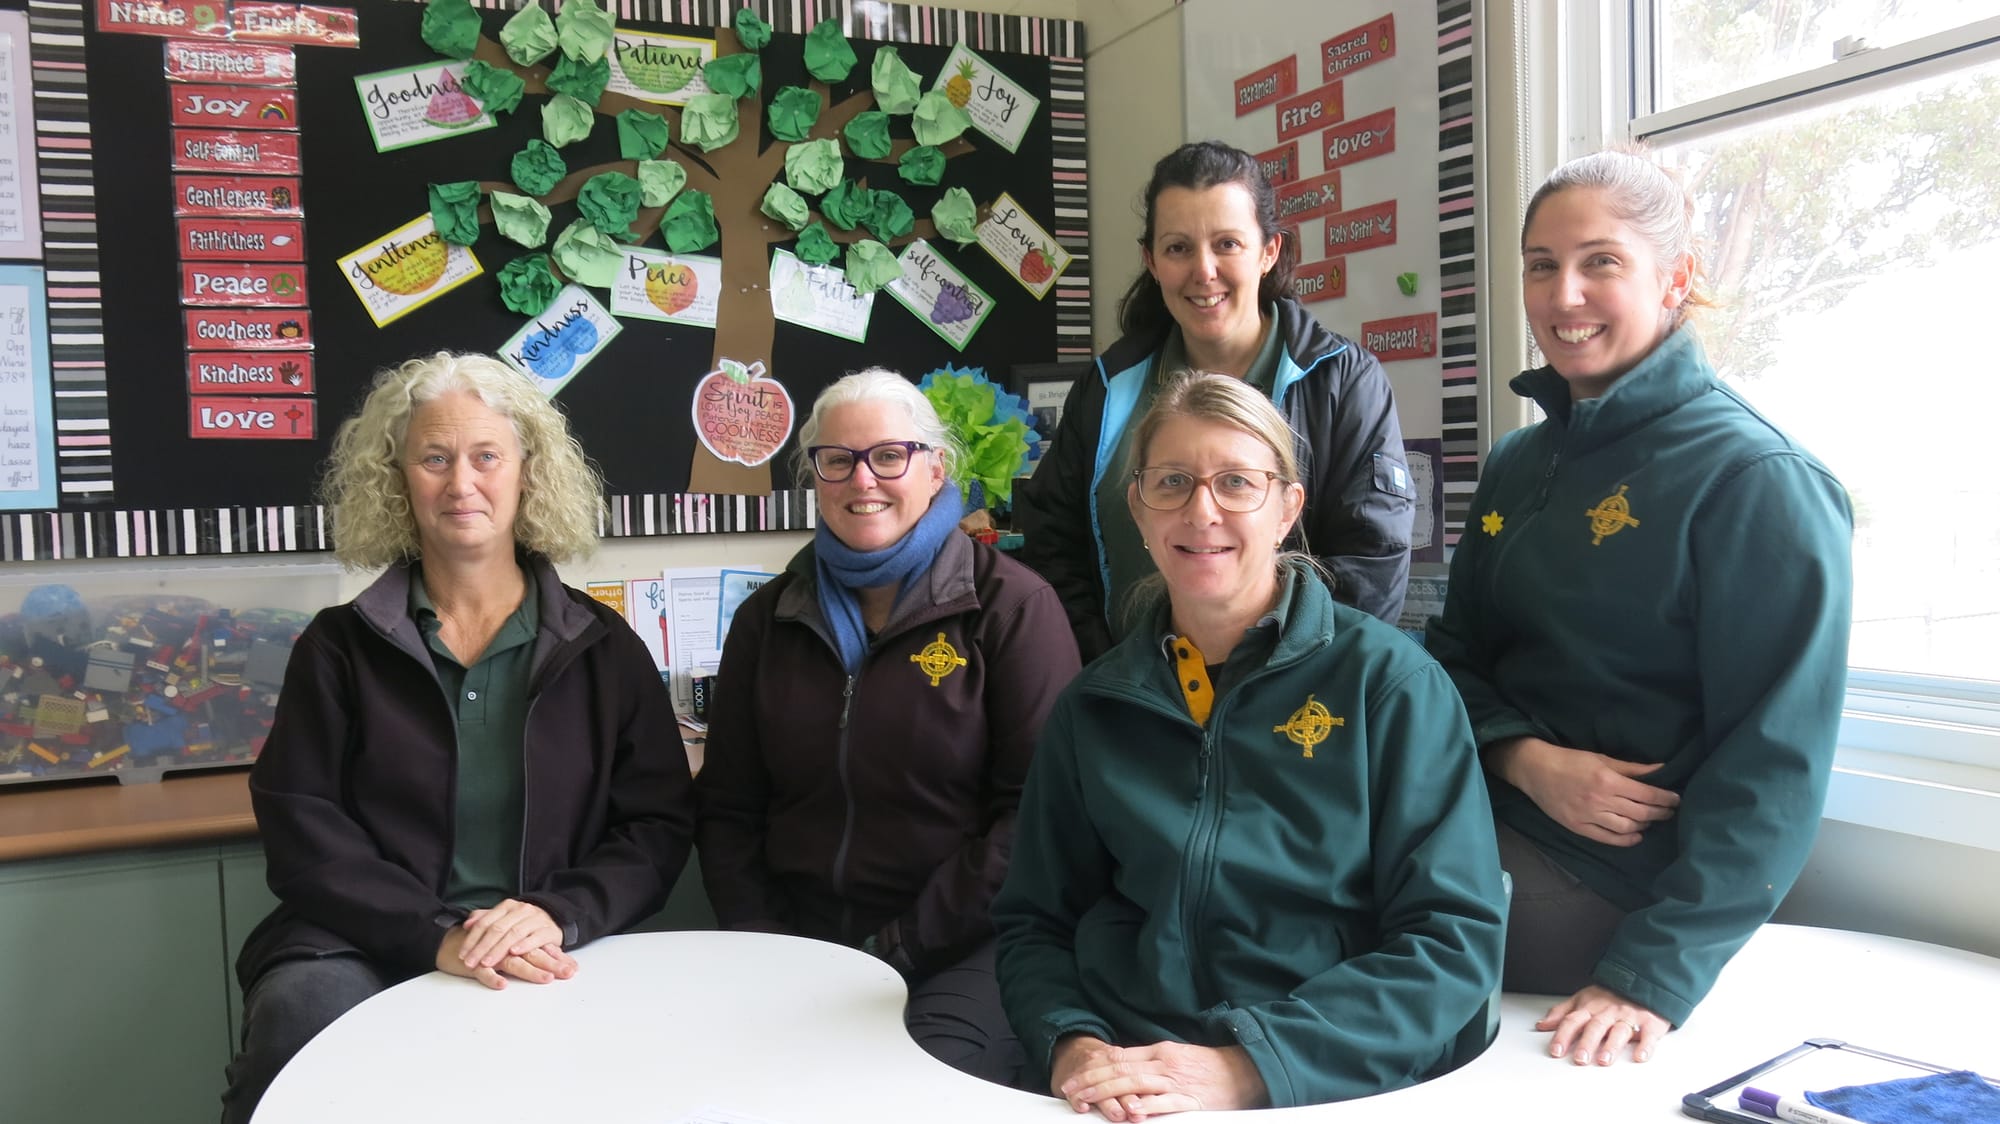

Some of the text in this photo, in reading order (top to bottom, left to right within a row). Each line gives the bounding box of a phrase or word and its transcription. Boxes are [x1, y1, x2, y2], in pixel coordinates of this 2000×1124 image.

[110, 1, 317, 35] Nine 9 Fruits
[614, 36, 706, 70] Patience
[1327, 32, 1368, 59] Sacred
[179, 49, 255, 73] Patience
[1327, 51, 1372, 75] Chrism
[184, 95, 250, 118] Joy
[976, 74, 1020, 123] Joy
[185, 140, 260, 161] Self-Control
[1328, 130, 1373, 160] dove
[186, 186, 267, 208] Gentleness
[189, 230, 266, 251] Faithfulness
[992, 209, 1036, 252] Love
[1350, 219, 1374, 242] Spirit
[628, 254, 691, 287] Peace
[192, 273, 268, 295] Peace
[197, 320, 272, 340] Goodness
[1366, 326, 1419, 352] Pentecost
[199, 363, 275, 384] Kindness
[200, 407, 276, 430] Love
[701, 402, 725, 413] LOVE
[755, 409, 785, 423] PEACE
